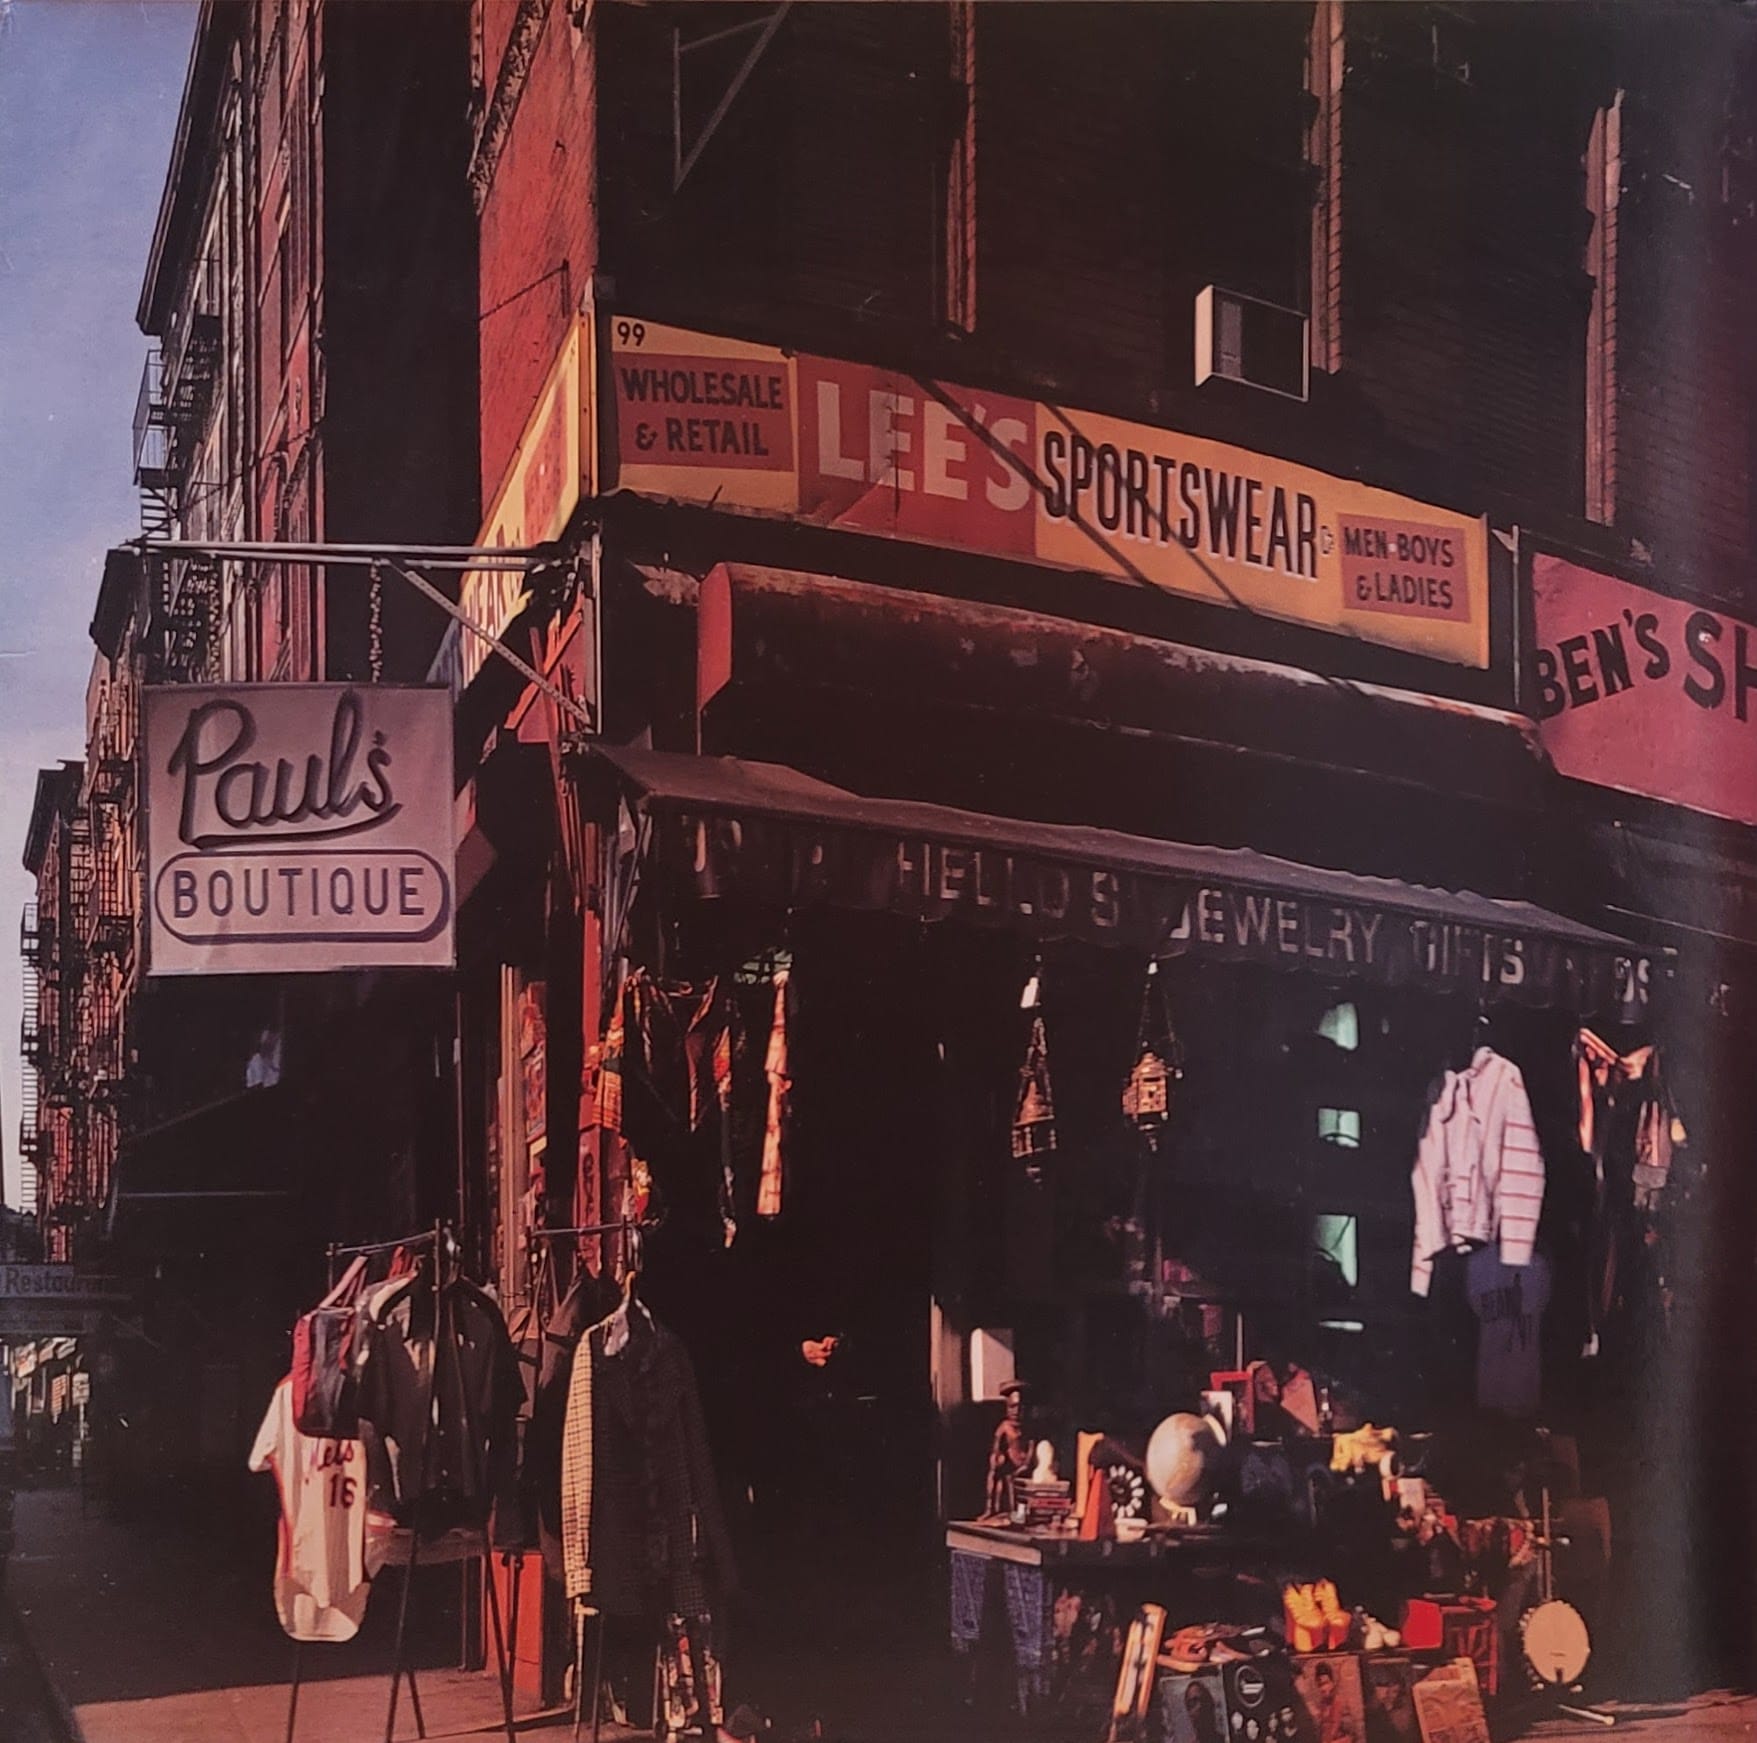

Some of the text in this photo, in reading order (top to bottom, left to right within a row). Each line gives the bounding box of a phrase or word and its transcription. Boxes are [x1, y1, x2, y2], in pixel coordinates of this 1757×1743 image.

[617, 321, 646, 347] 99
[620, 367, 784, 410] WHOLESALE
[635, 417, 769, 456] & RETAIL
[816, 380, 1319, 581] LEE'S SPORTSWEAR
[1343, 526, 1455, 568] MEN BOYS
[1375, 571, 1453, 609] LADIES
[1533, 609, 1671, 721] BEN'S
[166, 688, 404, 849] Paul's
[173, 867, 425, 919] BOUTIQUE
[329, 1473, 358, 1509] 16
